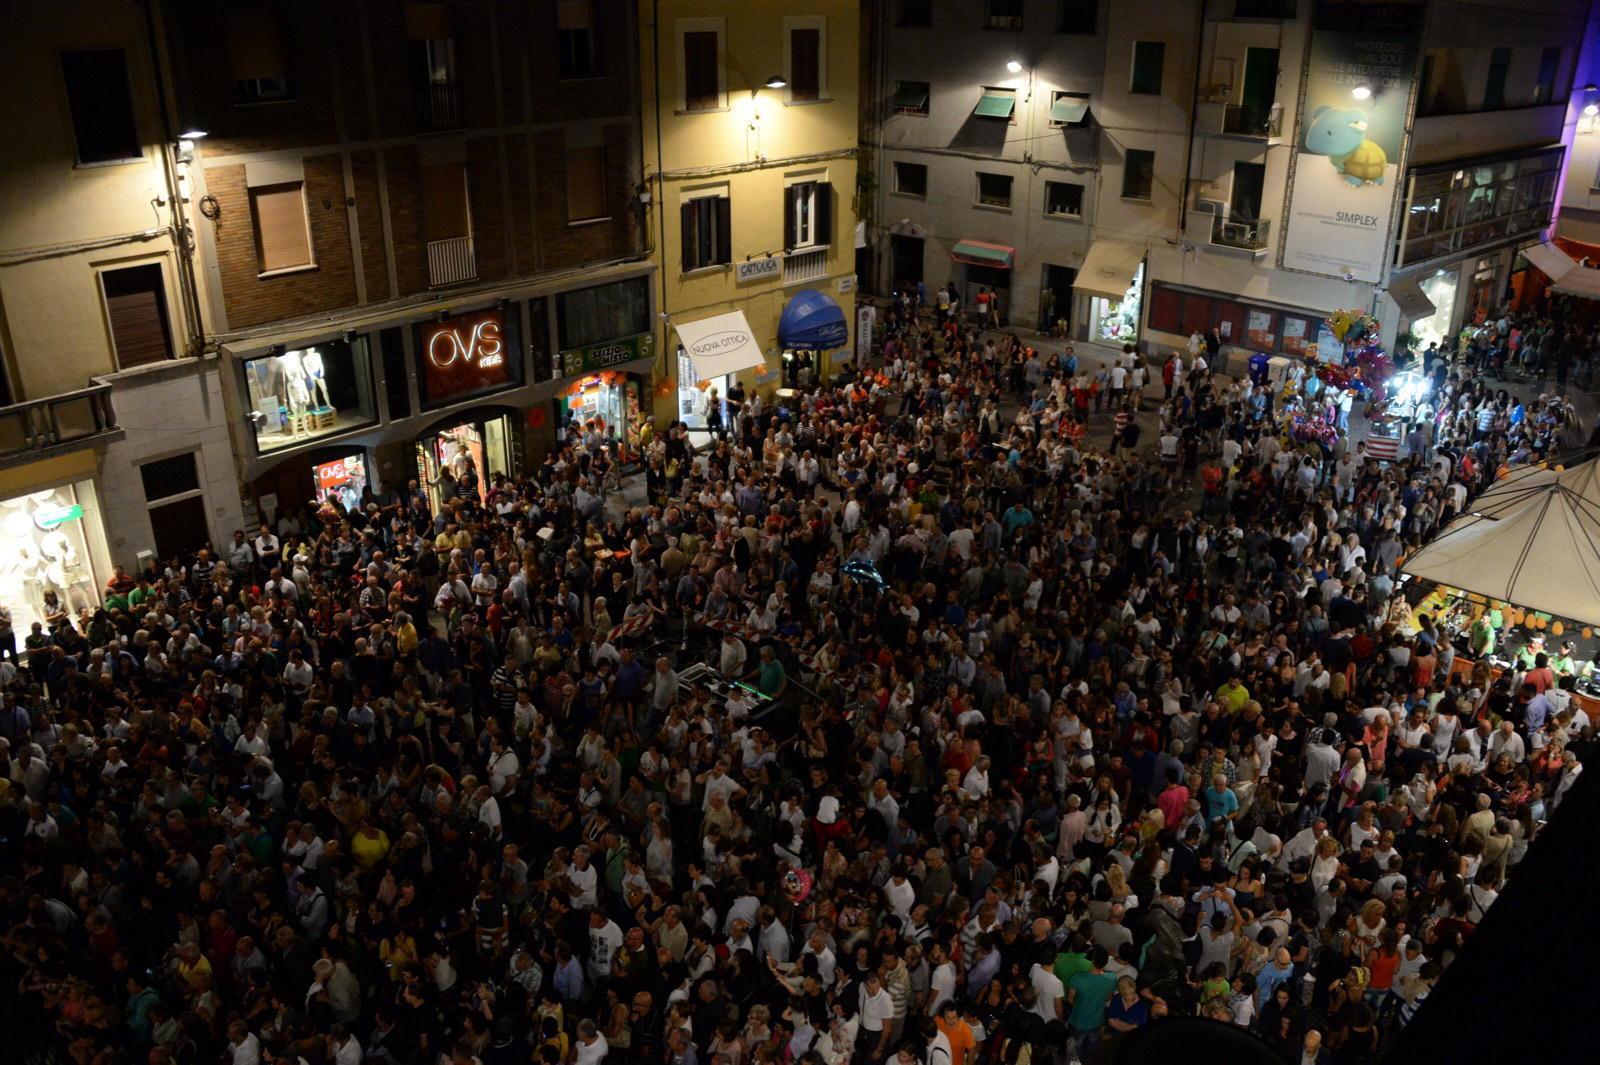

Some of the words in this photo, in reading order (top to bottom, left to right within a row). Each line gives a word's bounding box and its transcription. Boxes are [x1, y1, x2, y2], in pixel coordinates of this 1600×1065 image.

[1336, 211, 1379, 226] SIMPLEX
[429, 321, 501, 367] OVS
[692, 341, 720, 353] NUOVA
[721, 334, 747, 347] OTTICA
